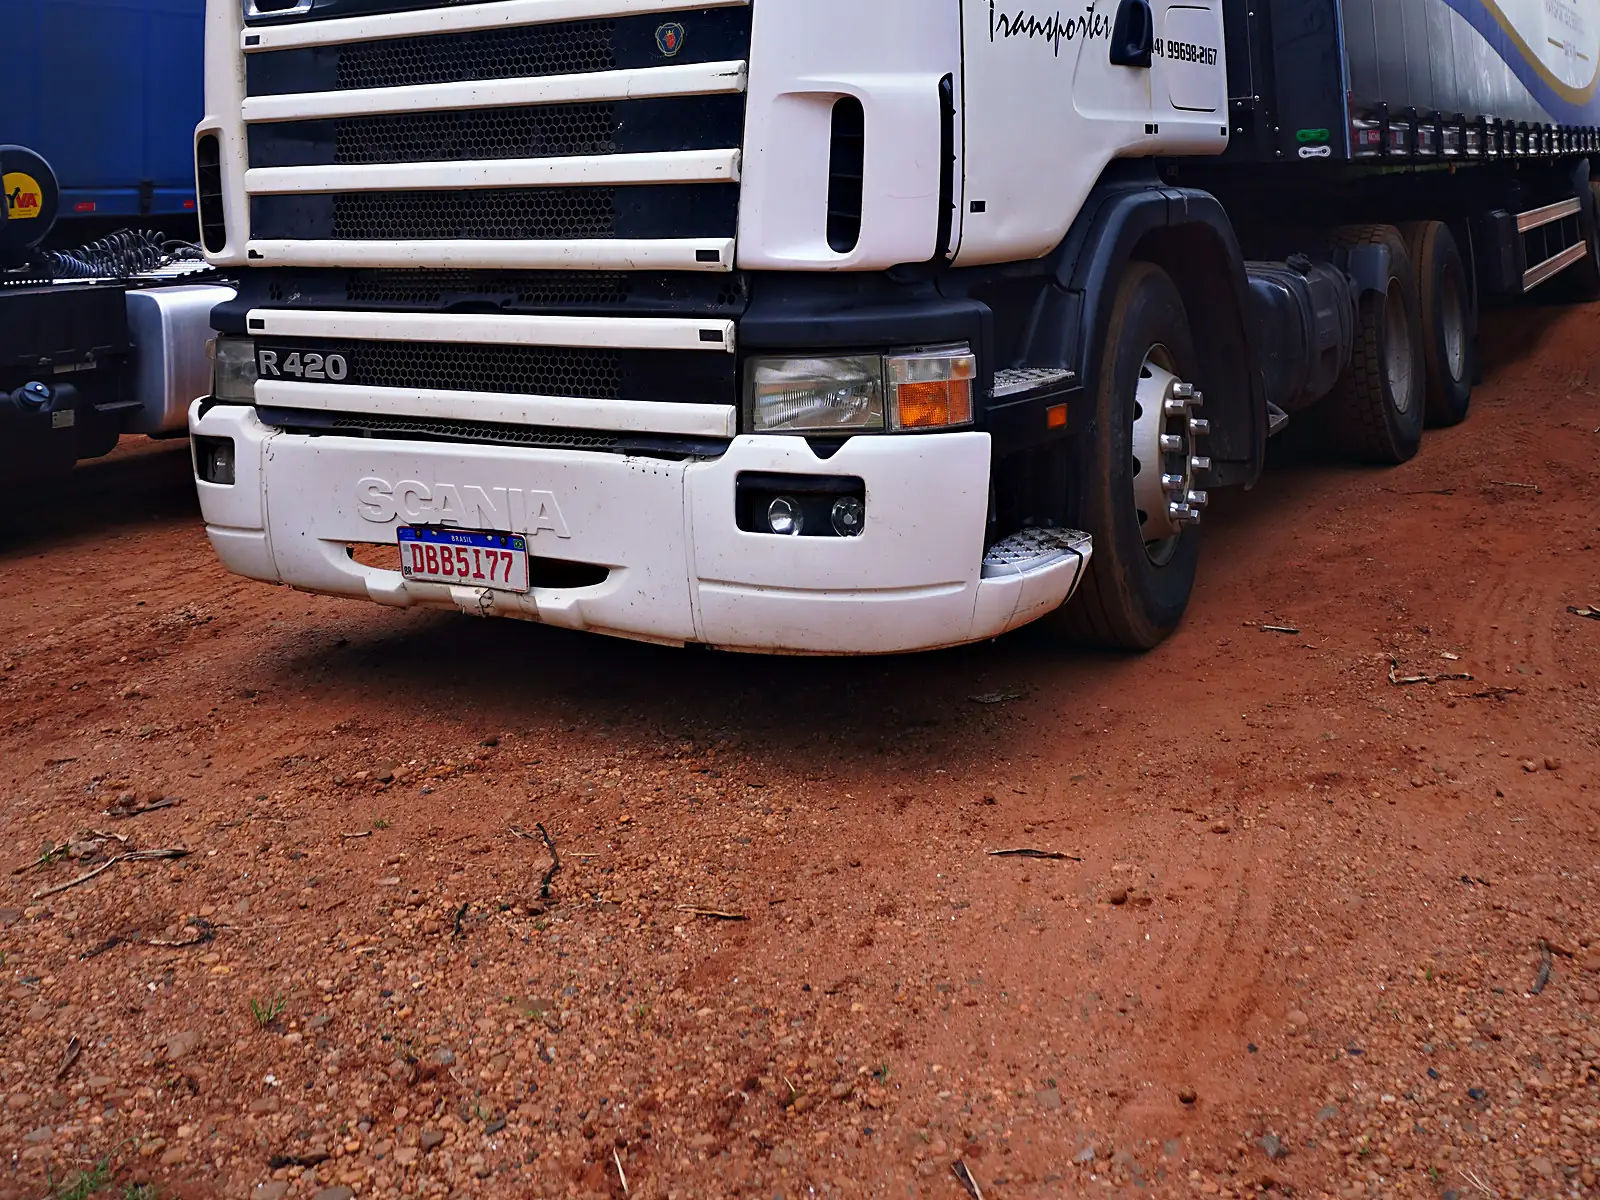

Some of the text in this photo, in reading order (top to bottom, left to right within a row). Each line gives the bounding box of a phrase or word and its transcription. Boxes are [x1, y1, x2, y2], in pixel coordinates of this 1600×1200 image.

[1167, 40, 1217, 66] 99698-2167
[5, 186, 38, 209] YVA
[258, 350, 348, 381] R 420
[356, 476, 571, 539] SCANIA
[451, 535, 473, 544] BRASIL
[403, 565, 413, 576] BR
